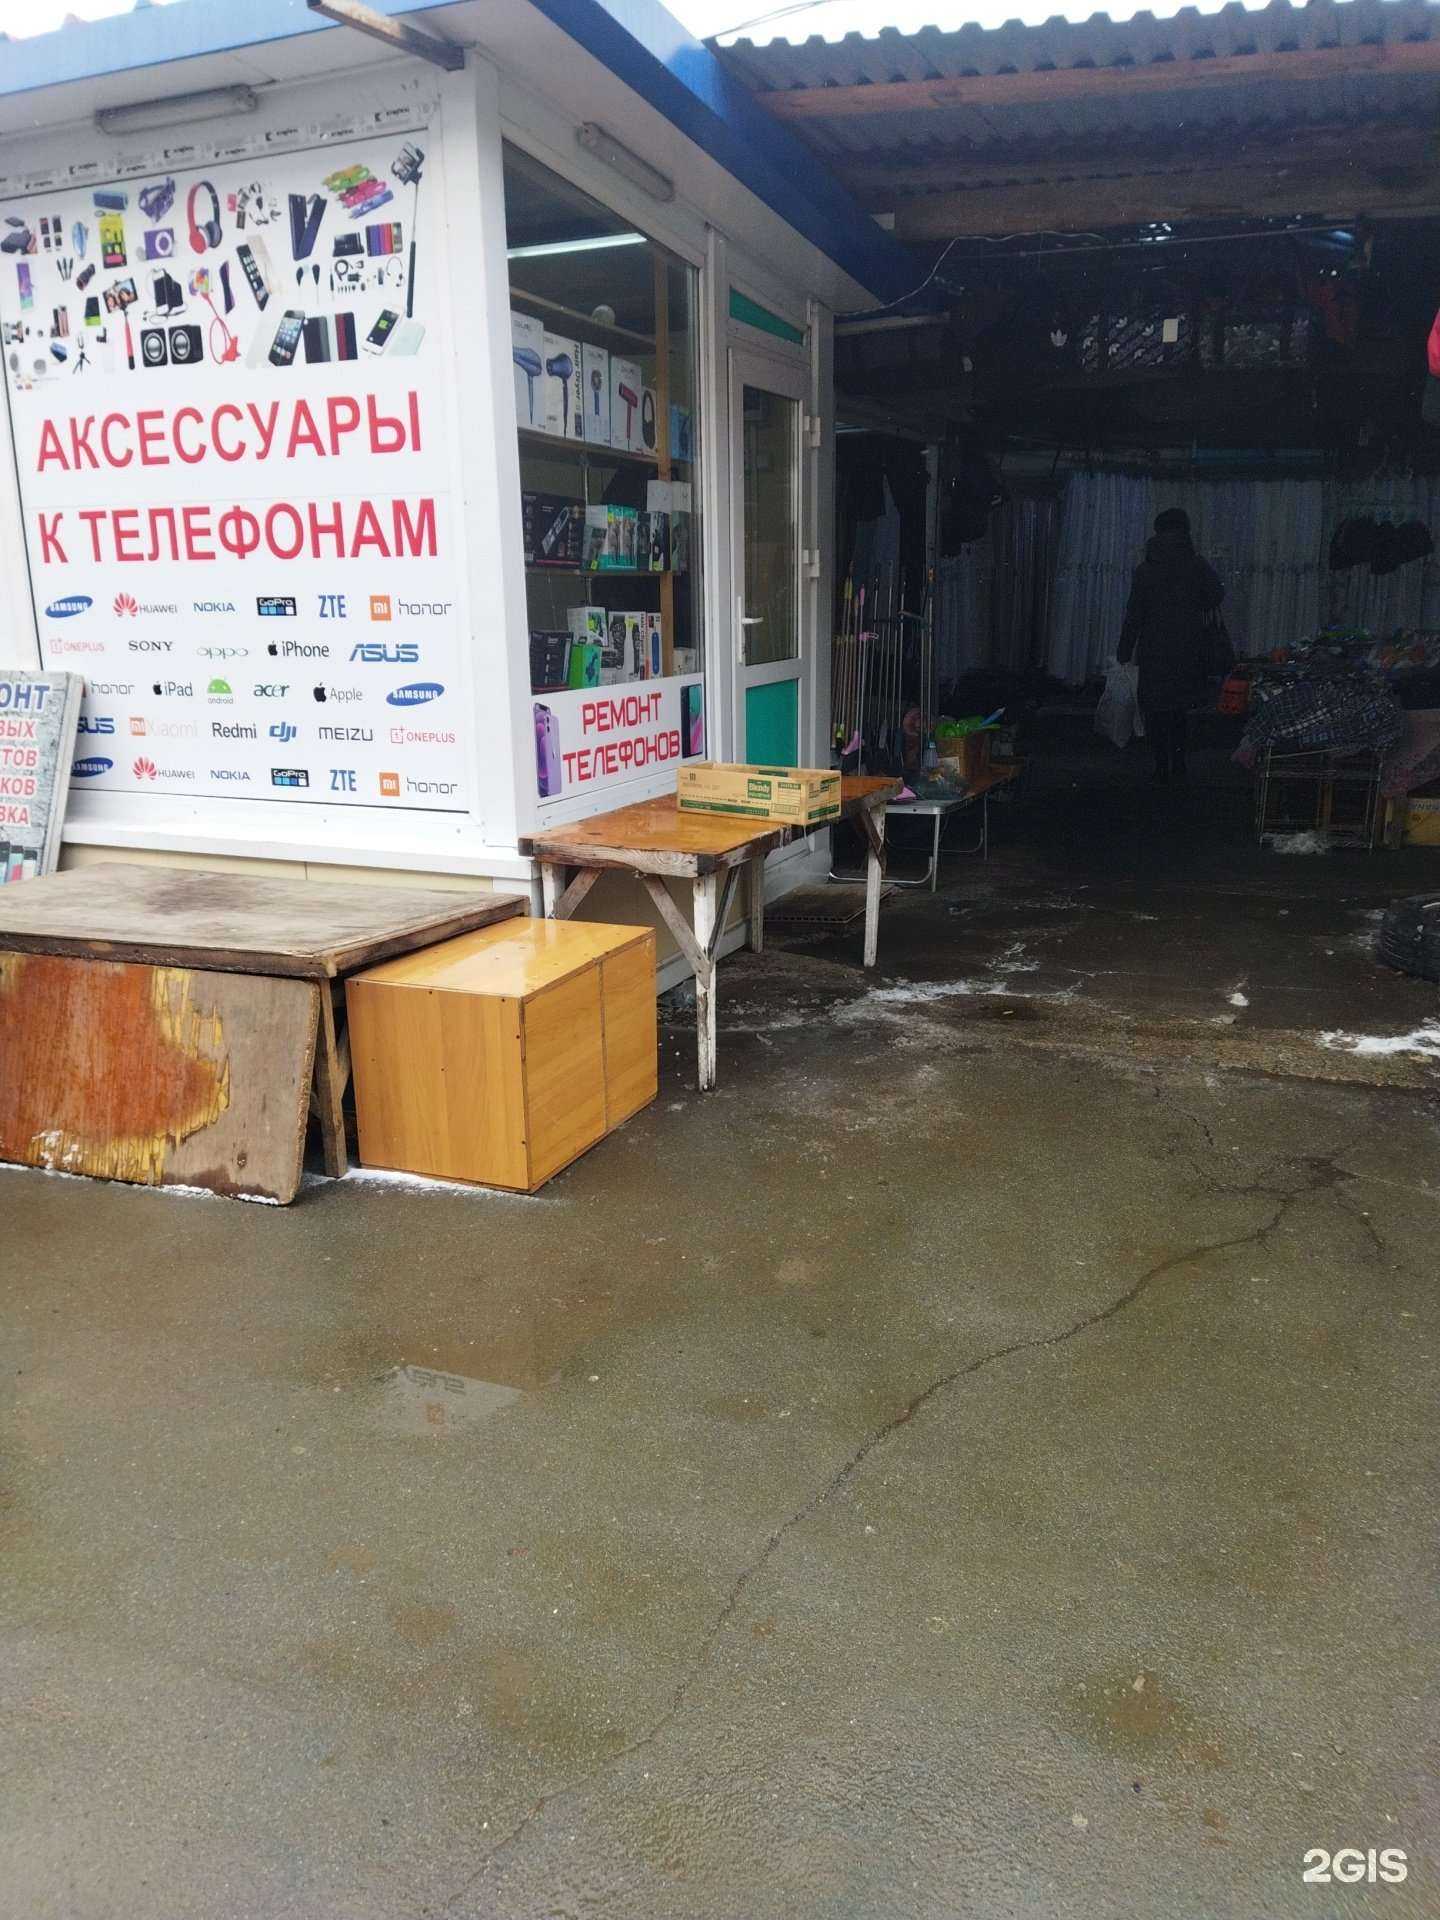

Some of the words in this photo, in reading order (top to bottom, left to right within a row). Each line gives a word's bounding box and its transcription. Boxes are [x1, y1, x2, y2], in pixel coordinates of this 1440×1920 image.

[37, 391, 422, 472] АКСЕССУАРЫ
[38, 512, 68, 564] К
[79, 498, 438, 563] ТЕЛЕФОНАМ
[139, 603, 178, 614] HUAWEI
[193, 602, 236, 612] NOKIA
[258, 598, 294, 607] GoPro
[318, 595, 347, 618] ZTE
[399, 599, 452, 616] honor
[64, 641, 104, 652] ONEPLUS
[128, 640, 173, 651] SONY
[196, 647, 249, 659] oppo
[282, 641, 330, 658] iPhone
[349, 643, 419, 663] ASUS
[91, 682, 135, 695] honor
[164, 682, 194, 697] iPad
[207, 697, 234, 705] android
[253, 684, 290, 698] acer
[330, 687, 363, 703] Apple
[392, 690, 437, 700] SAMSUNG
[582, 693, 662, 735] РЕМОНТ
[77, 717, 115, 734] SUS
[212, 722, 257, 739] Redmi
[269, 721, 297, 743] dji
[319, 726, 374, 742] MEIZU
[407, 733, 456, 744] ONEPLUS
[562, 730, 682, 784] ТЕЛЕФОНОВ
[158, 769, 195, 780] HUAWEI
[210, 769, 251, 781] NOKIA
[273, 769, 306, 778] GoPro
[330, 769, 357, 792] ZTE
[407, 776, 458, 794] honor
